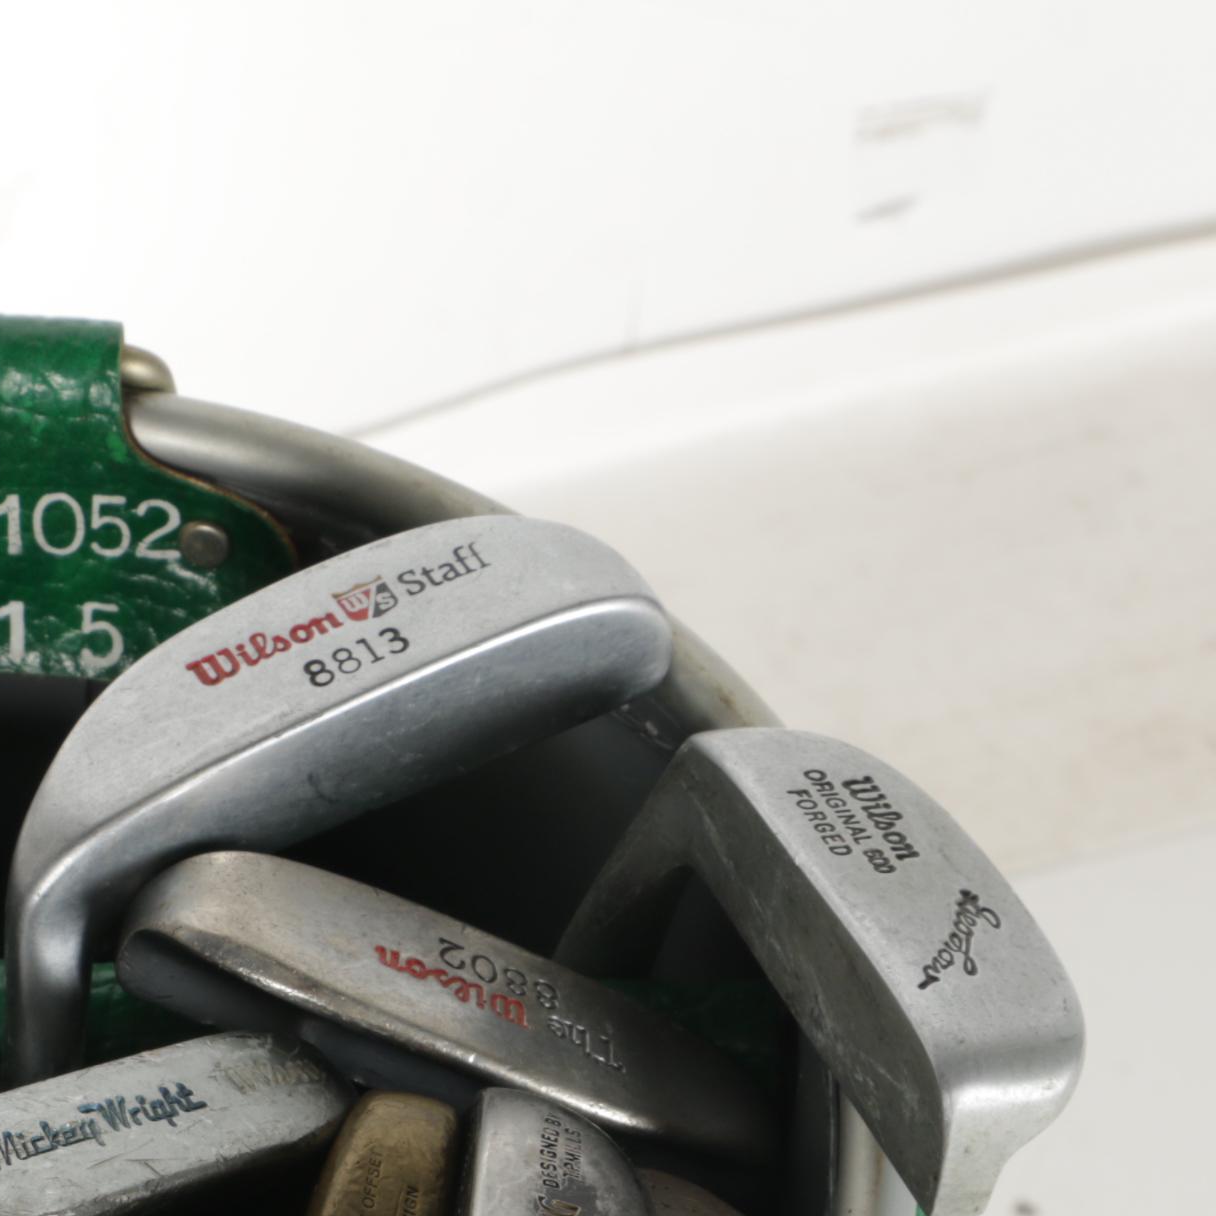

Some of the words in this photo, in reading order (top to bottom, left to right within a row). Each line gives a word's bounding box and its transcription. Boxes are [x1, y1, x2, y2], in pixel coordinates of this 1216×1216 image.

[185, 611, 344, 687] Wilson
[397, 541, 491, 597] Staff
[303, 626, 410, 687] 8813
[786, 789, 853, 856] FORGED
[803, 769, 872, 845] ORIGINAL
[842, 775, 920, 861] Wilson
[374, 944, 529, 1030] Wilson
[438, 937, 559, 1010] 8802
[547, 1014, 626, 1074] The
[78, 1082, 208, 1132] Wright
[540, 1127, 561, 1188] DESIGNED
